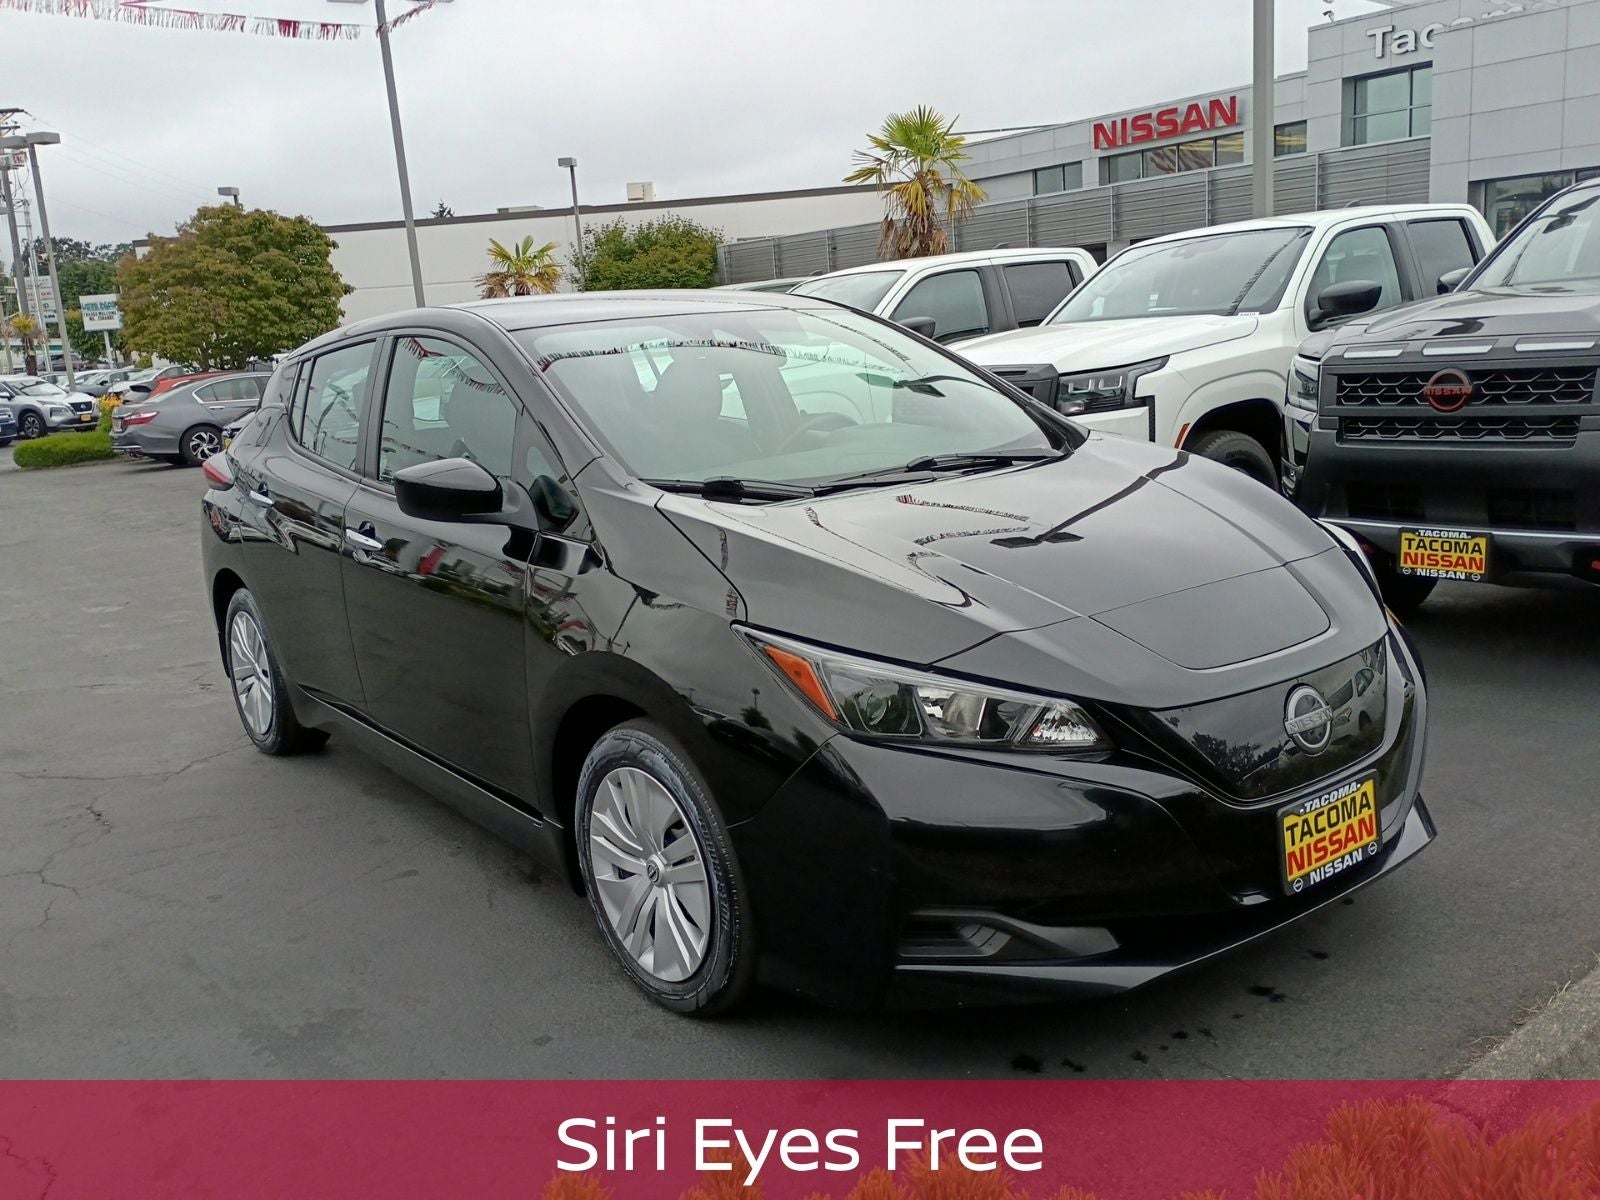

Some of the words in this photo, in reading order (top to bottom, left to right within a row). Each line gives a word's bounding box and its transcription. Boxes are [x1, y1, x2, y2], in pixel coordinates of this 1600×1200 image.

[1093, 95, 1237, 149] NISSAN
[1423, 387, 1472, 396] NISSAN
[1418, 529, 1468, 539] TACOMA
[1404, 537, 1483, 555] TACOMA
[1403, 552, 1484, 571] NISSAN
[1416, 568, 1466, 579] NISSAN
[1287, 709, 1333, 732] NISSAN
[1304, 781, 1358, 813] TACOMA
[1286, 790, 1372, 847] TACOMA
[1287, 813, 1374, 877] NISSAN
[1310, 848, 1363, 885] NISSAN
